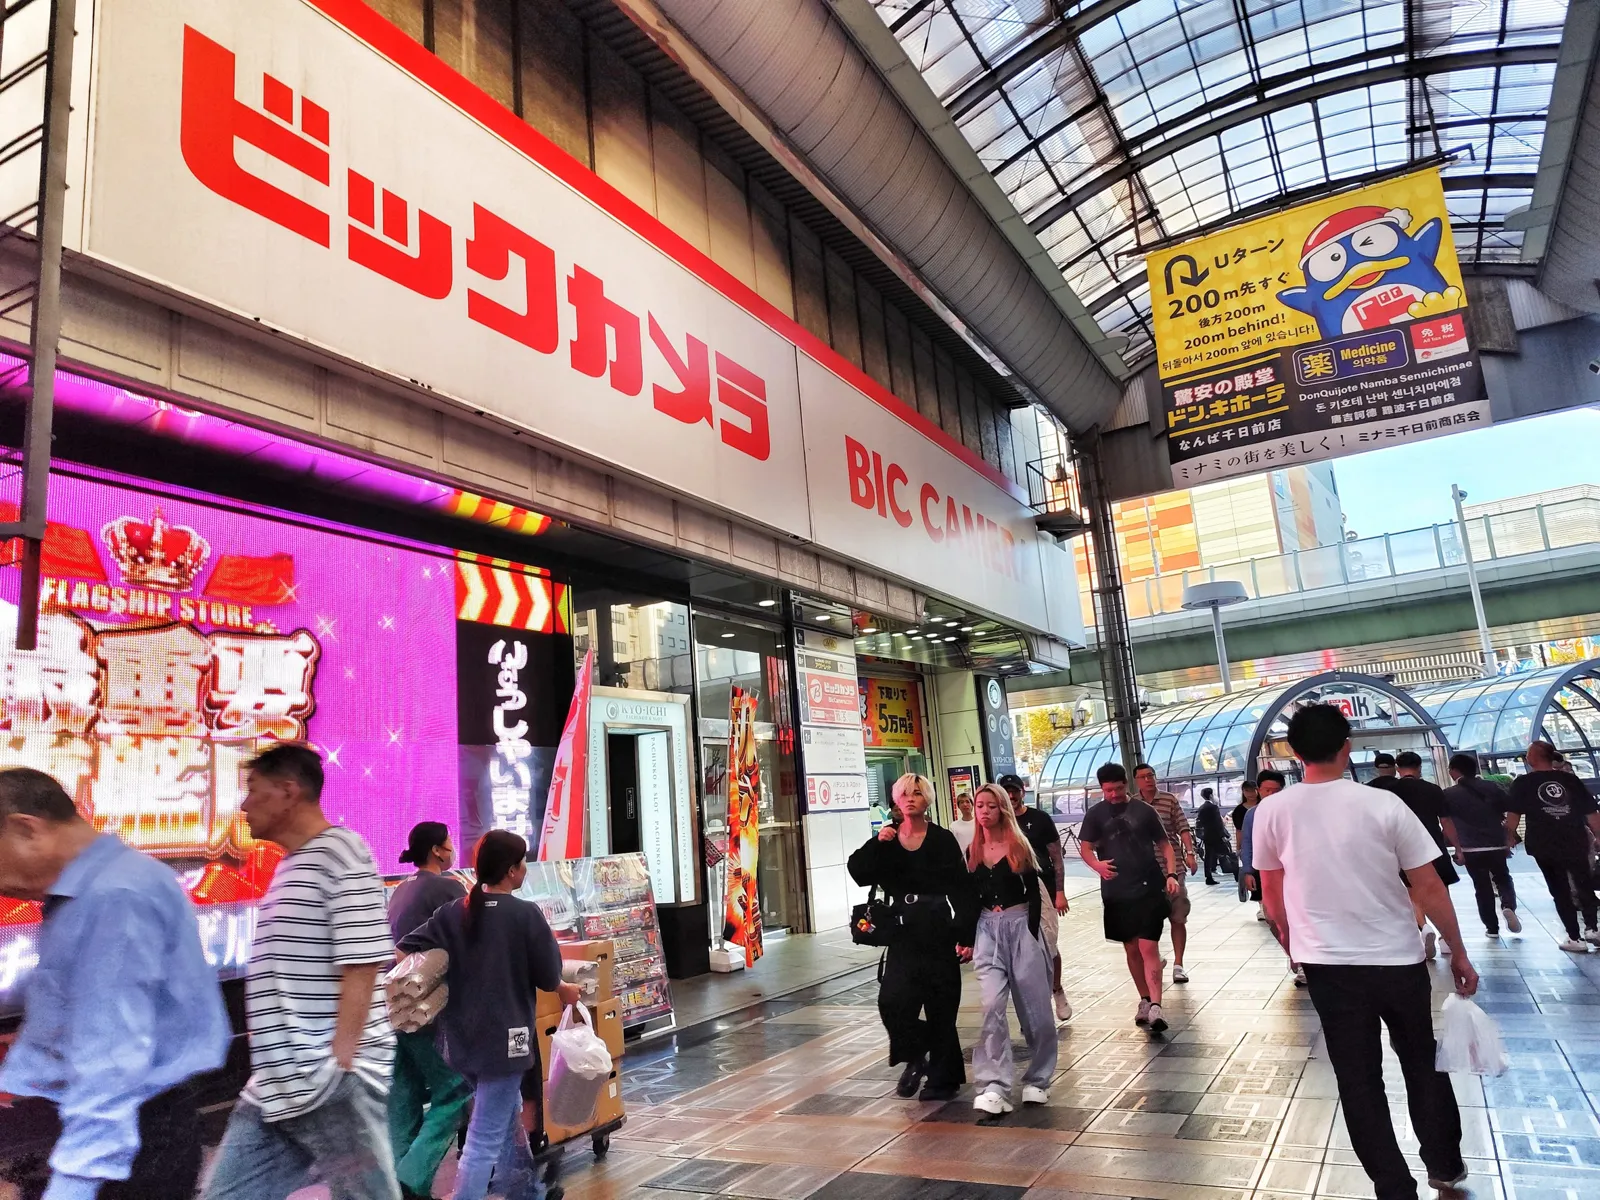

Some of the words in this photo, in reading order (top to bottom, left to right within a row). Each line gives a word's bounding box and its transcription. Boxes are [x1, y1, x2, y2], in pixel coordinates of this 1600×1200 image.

[181, 23, 771, 461] ビックカメラ
[1214, 238, 1285, 269] Uターン
[1162, 352, 1203, 371] 뒤돌아서
[1205, 346, 1239, 360] 200m
[1240, 336, 1263, 351] 앞에
[1265, 324, 1315, 343] 있습니다!
[1184, 332, 1225, 350] 200m
[1228, 313, 1286, 338] behind!
[1302, 352, 1334, 379] 薬
[1340, 341, 1396, 361] Medicine
[1173, 366, 1275, 407] 驚安の殿堂
[1298, 385, 1358, 402] DonQuijote
[1359, 377, 1398, 390] Namba
[1399, 360, 1473, 383] Sennichimae
[1365, 393, 1388, 404] 난바
[1179, 418, 1282, 451] なんば千日前店
[1358, 410, 1480, 442] ミナミ千日前商店会
[845, 435, 913, 528] BIC
[41, 576, 172, 618] FLAGSHIP
[179, 597, 255, 627] STORE
[823, 681, 855, 696] ビックカメラ
[877, 685, 908, 702] 下取りで
[1337, 695, 1370, 718] alk
[650, 737, 658, 780] PACHINKO
[834, 791, 862, 804] キョーイチ
